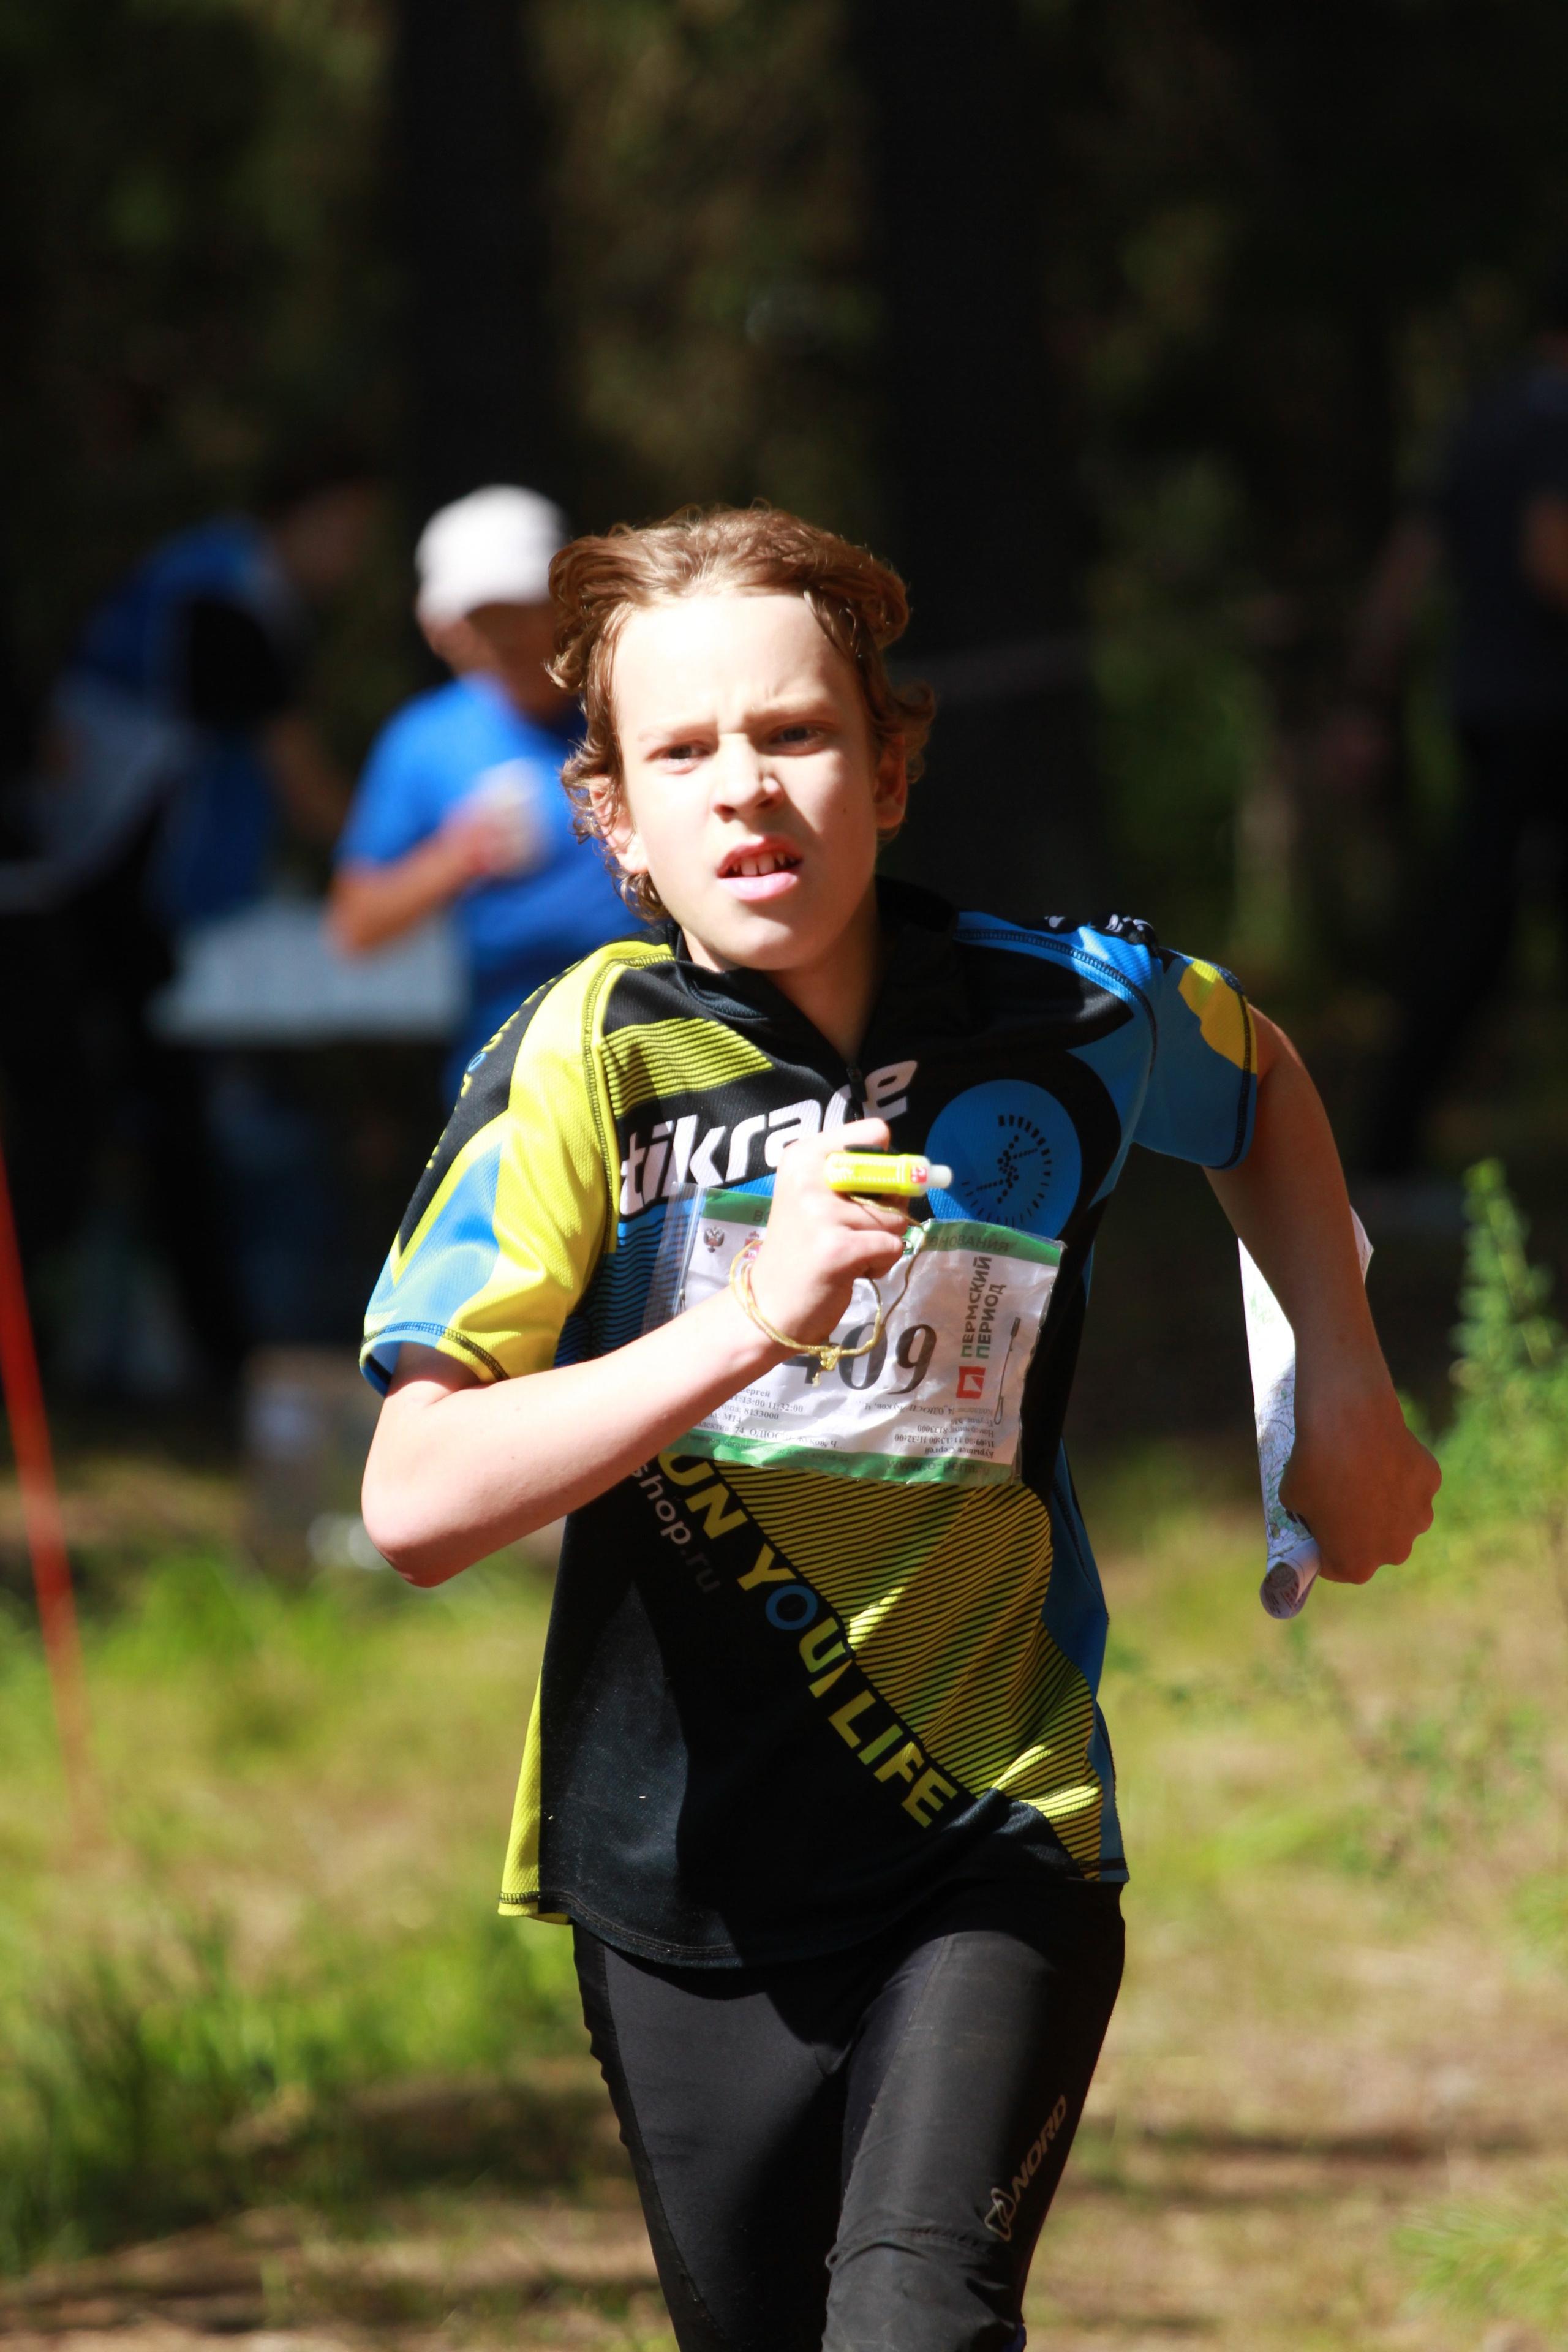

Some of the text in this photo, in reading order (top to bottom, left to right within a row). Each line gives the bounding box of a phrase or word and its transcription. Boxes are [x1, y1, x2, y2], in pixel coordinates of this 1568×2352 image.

[960, 1256, 992, 1358] ПЕРМСКИЙ
[975, 1284, 1006, 1359] ПЕРИОД
[744, 1408, 779, 1420] 8133000
[767, 1402, 804, 1412] 11:32:00
[894, 1433, 927, 1444] 11:32:00
[917, 1424, 948, 1434] 8133000
[827, 1689, 958, 1828] LIFE
[1012, 2094, 1067, 2203] NORD
